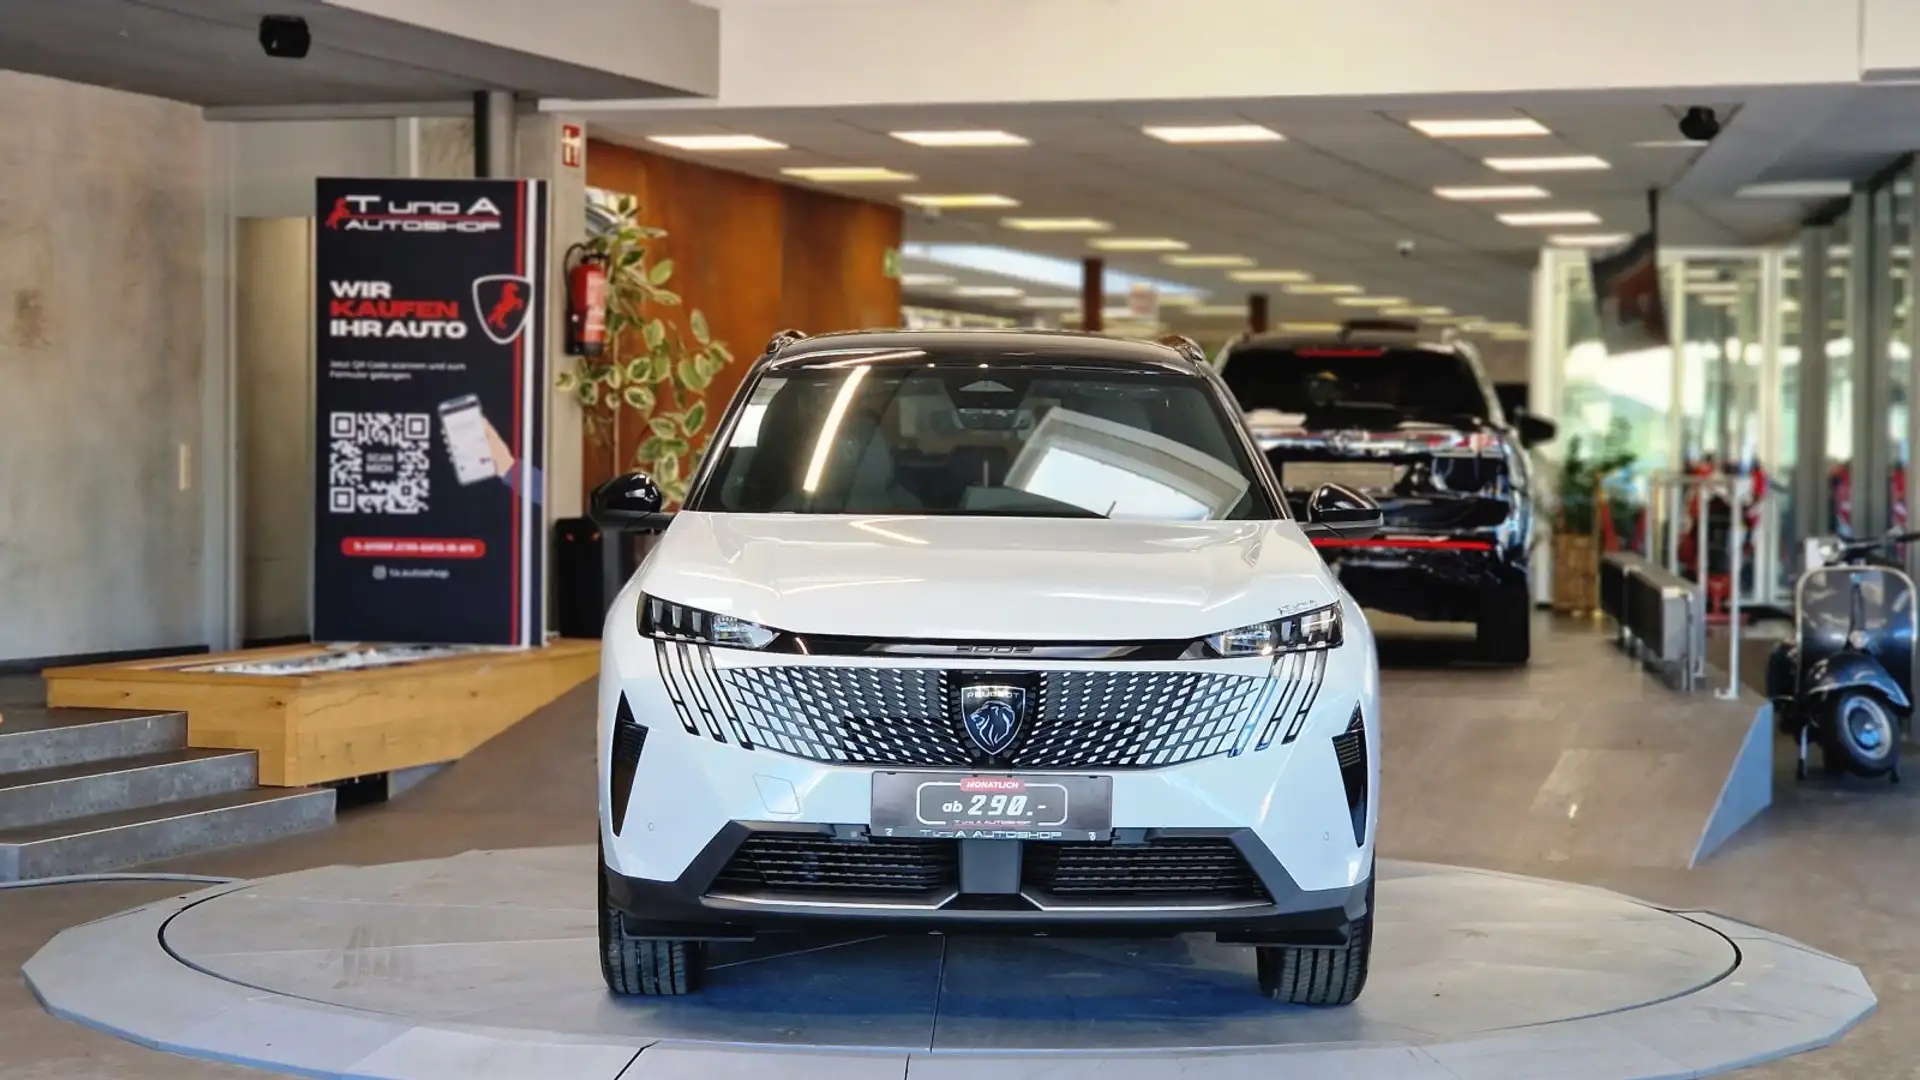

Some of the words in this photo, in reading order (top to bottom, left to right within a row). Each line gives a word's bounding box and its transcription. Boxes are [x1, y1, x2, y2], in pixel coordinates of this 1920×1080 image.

[345, 195, 382, 213] T
[466, 197, 501, 215] A
[344, 219, 501, 232] AUTOSHOP
[330, 281, 392, 298] WIR
[330, 301, 459, 318] KAUFEN
[330, 320, 383, 337] IHR
[387, 321, 467, 338] AUTO
[367, 361, 388, 369] Code
[391, 362, 426, 370] scannen
[428, 362, 445, 371] und
[447, 363, 466, 371] zum
[329, 370, 368, 379] Formular
[966, 691, 1020, 699] PEUGEOT
[966, 780, 1019, 789] MONATLICH
[942, 800, 963, 812] ab
[955, 830, 967, 838] A
[972, 830, 1062, 839] AUTOSHOP
